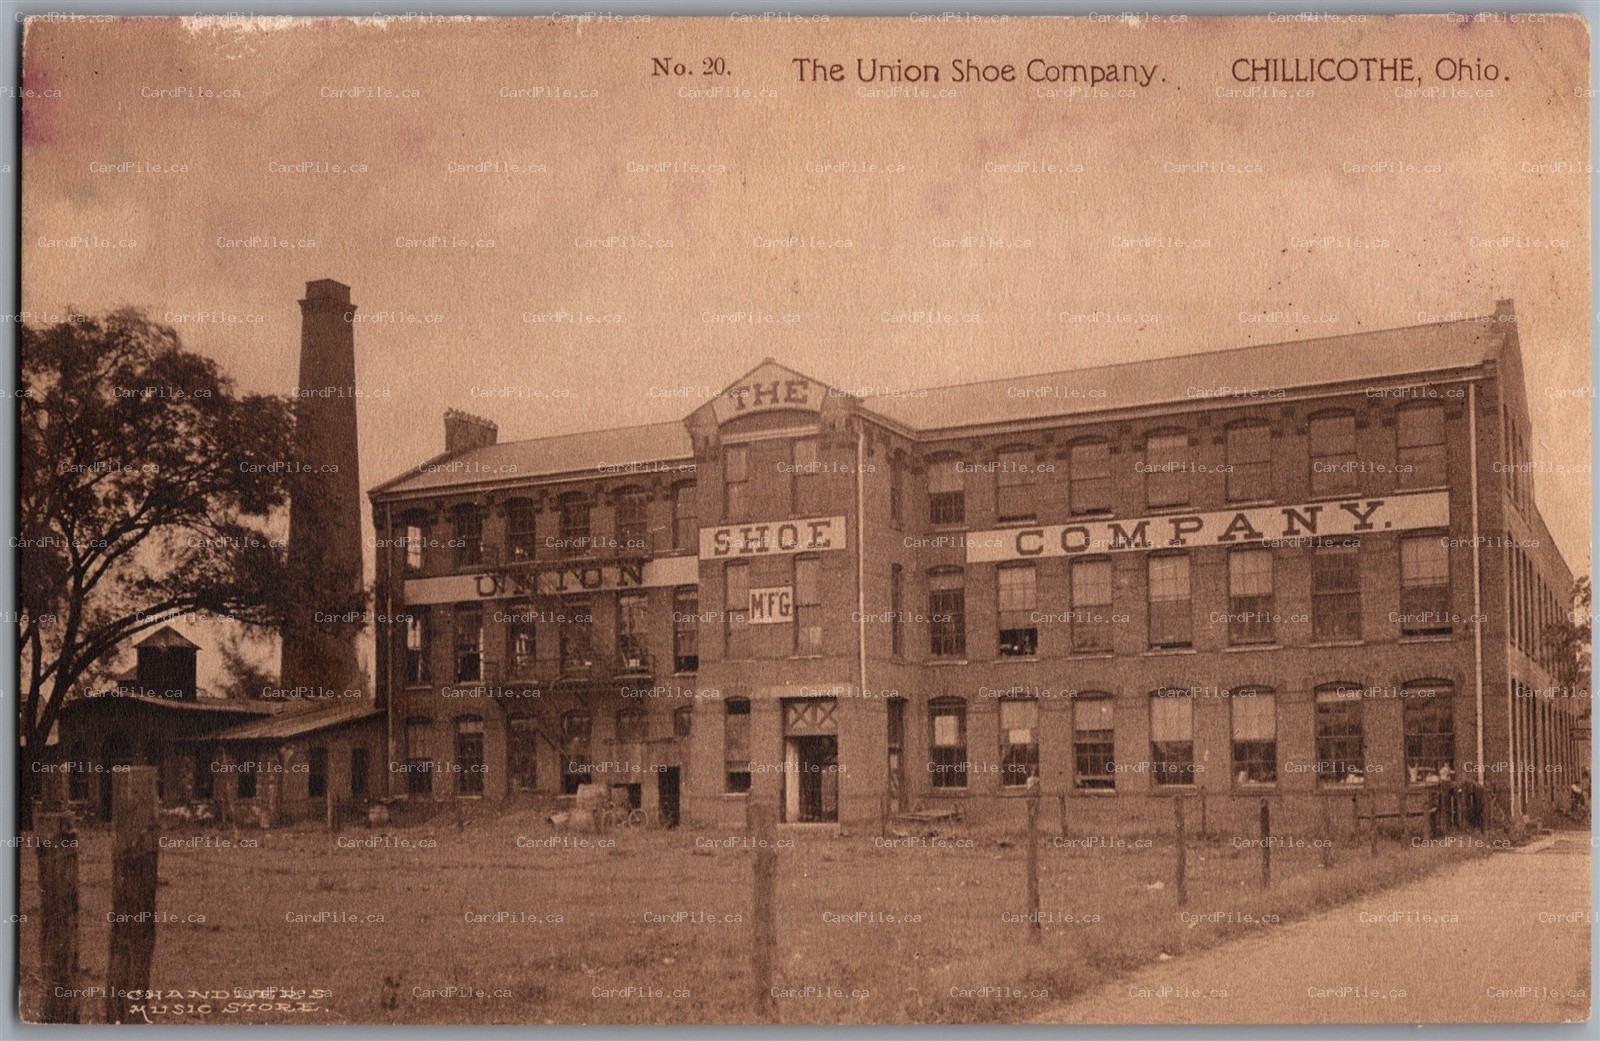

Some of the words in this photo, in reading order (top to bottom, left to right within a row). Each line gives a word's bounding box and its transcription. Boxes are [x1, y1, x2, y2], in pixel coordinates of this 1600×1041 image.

[729, 380, 809, 411] THE
[714, 520, 831, 556] SHOE
[1015, 501, 1391, 556] COMPANY.
[474, 559, 646, 598] UNION
